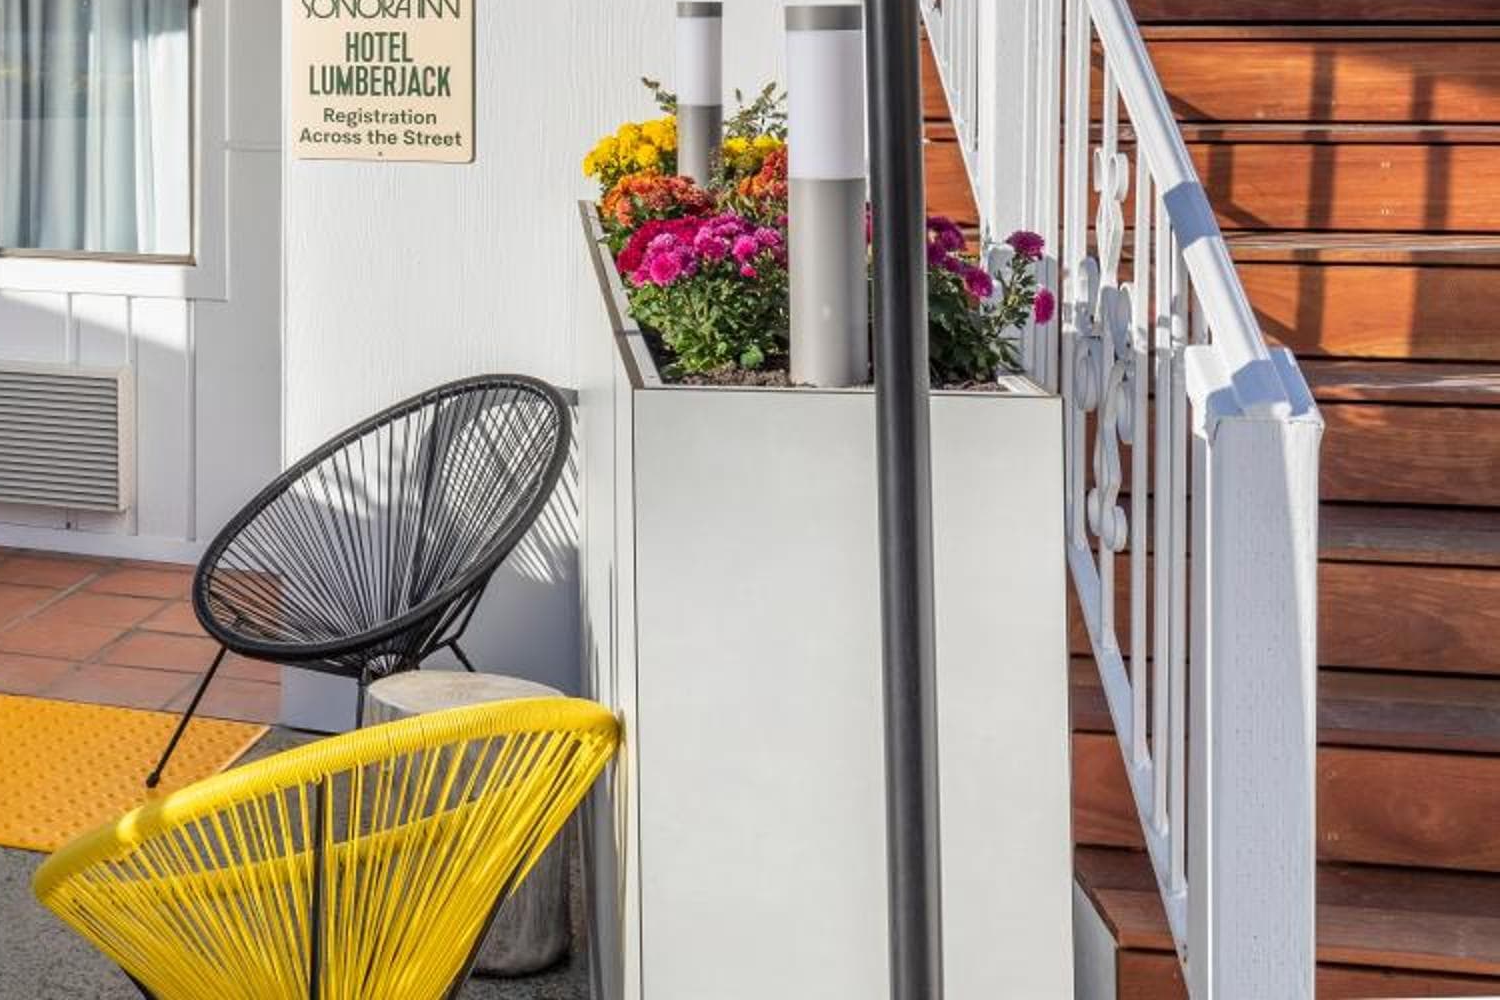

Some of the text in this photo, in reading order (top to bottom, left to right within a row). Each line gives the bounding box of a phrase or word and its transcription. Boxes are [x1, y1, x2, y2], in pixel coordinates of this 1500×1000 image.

[345, 31, 414, 63] HOTEL
[309, 65, 452, 97] LUMBERJACK
[323, 107, 438, 128] Registration
[299, 128, 463, 147] Across the Street
